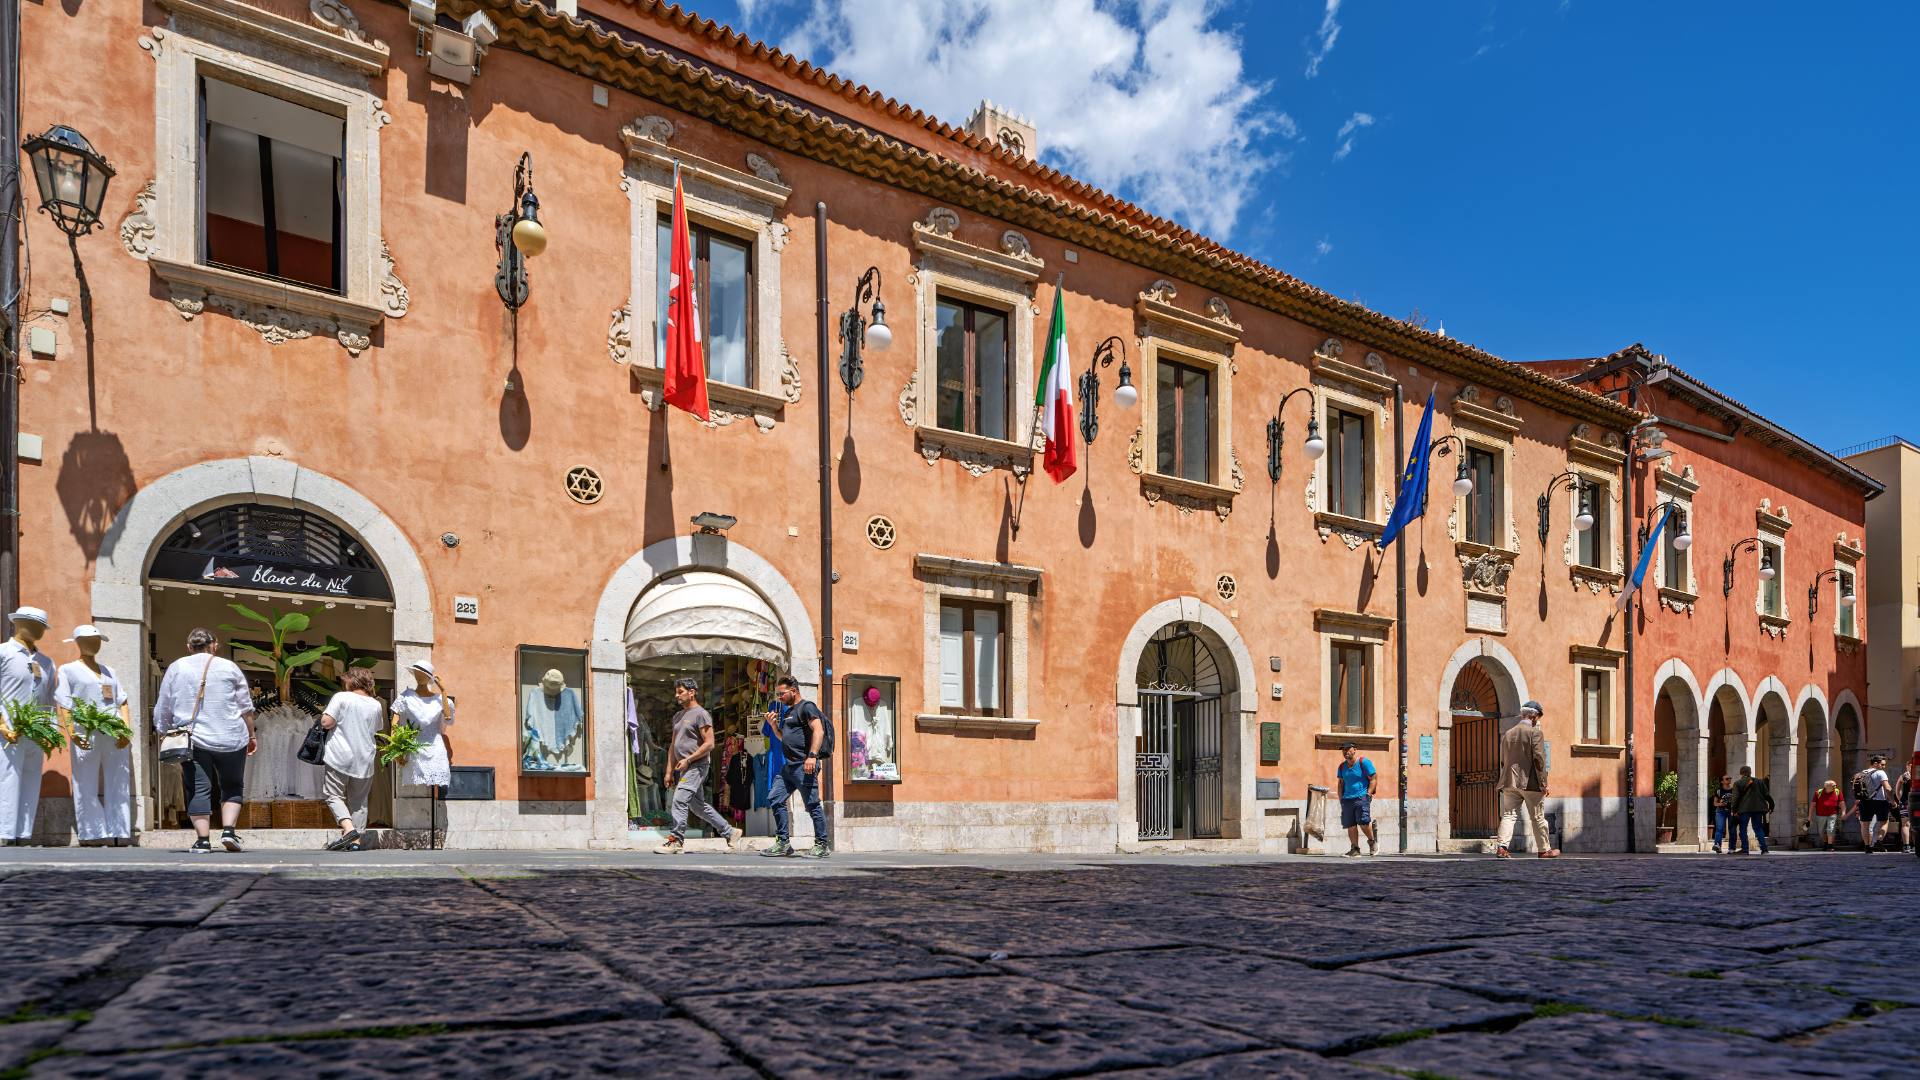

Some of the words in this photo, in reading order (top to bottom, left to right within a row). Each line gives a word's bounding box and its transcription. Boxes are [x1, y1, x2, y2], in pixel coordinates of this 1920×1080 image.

[251, 564, 298, 585] Blanc
[301, 572, 322, 588] du
[325, 575, 353, 591] Nil
[456, 602, 477, 614] 223
[843, 635, 857, 646] 221
